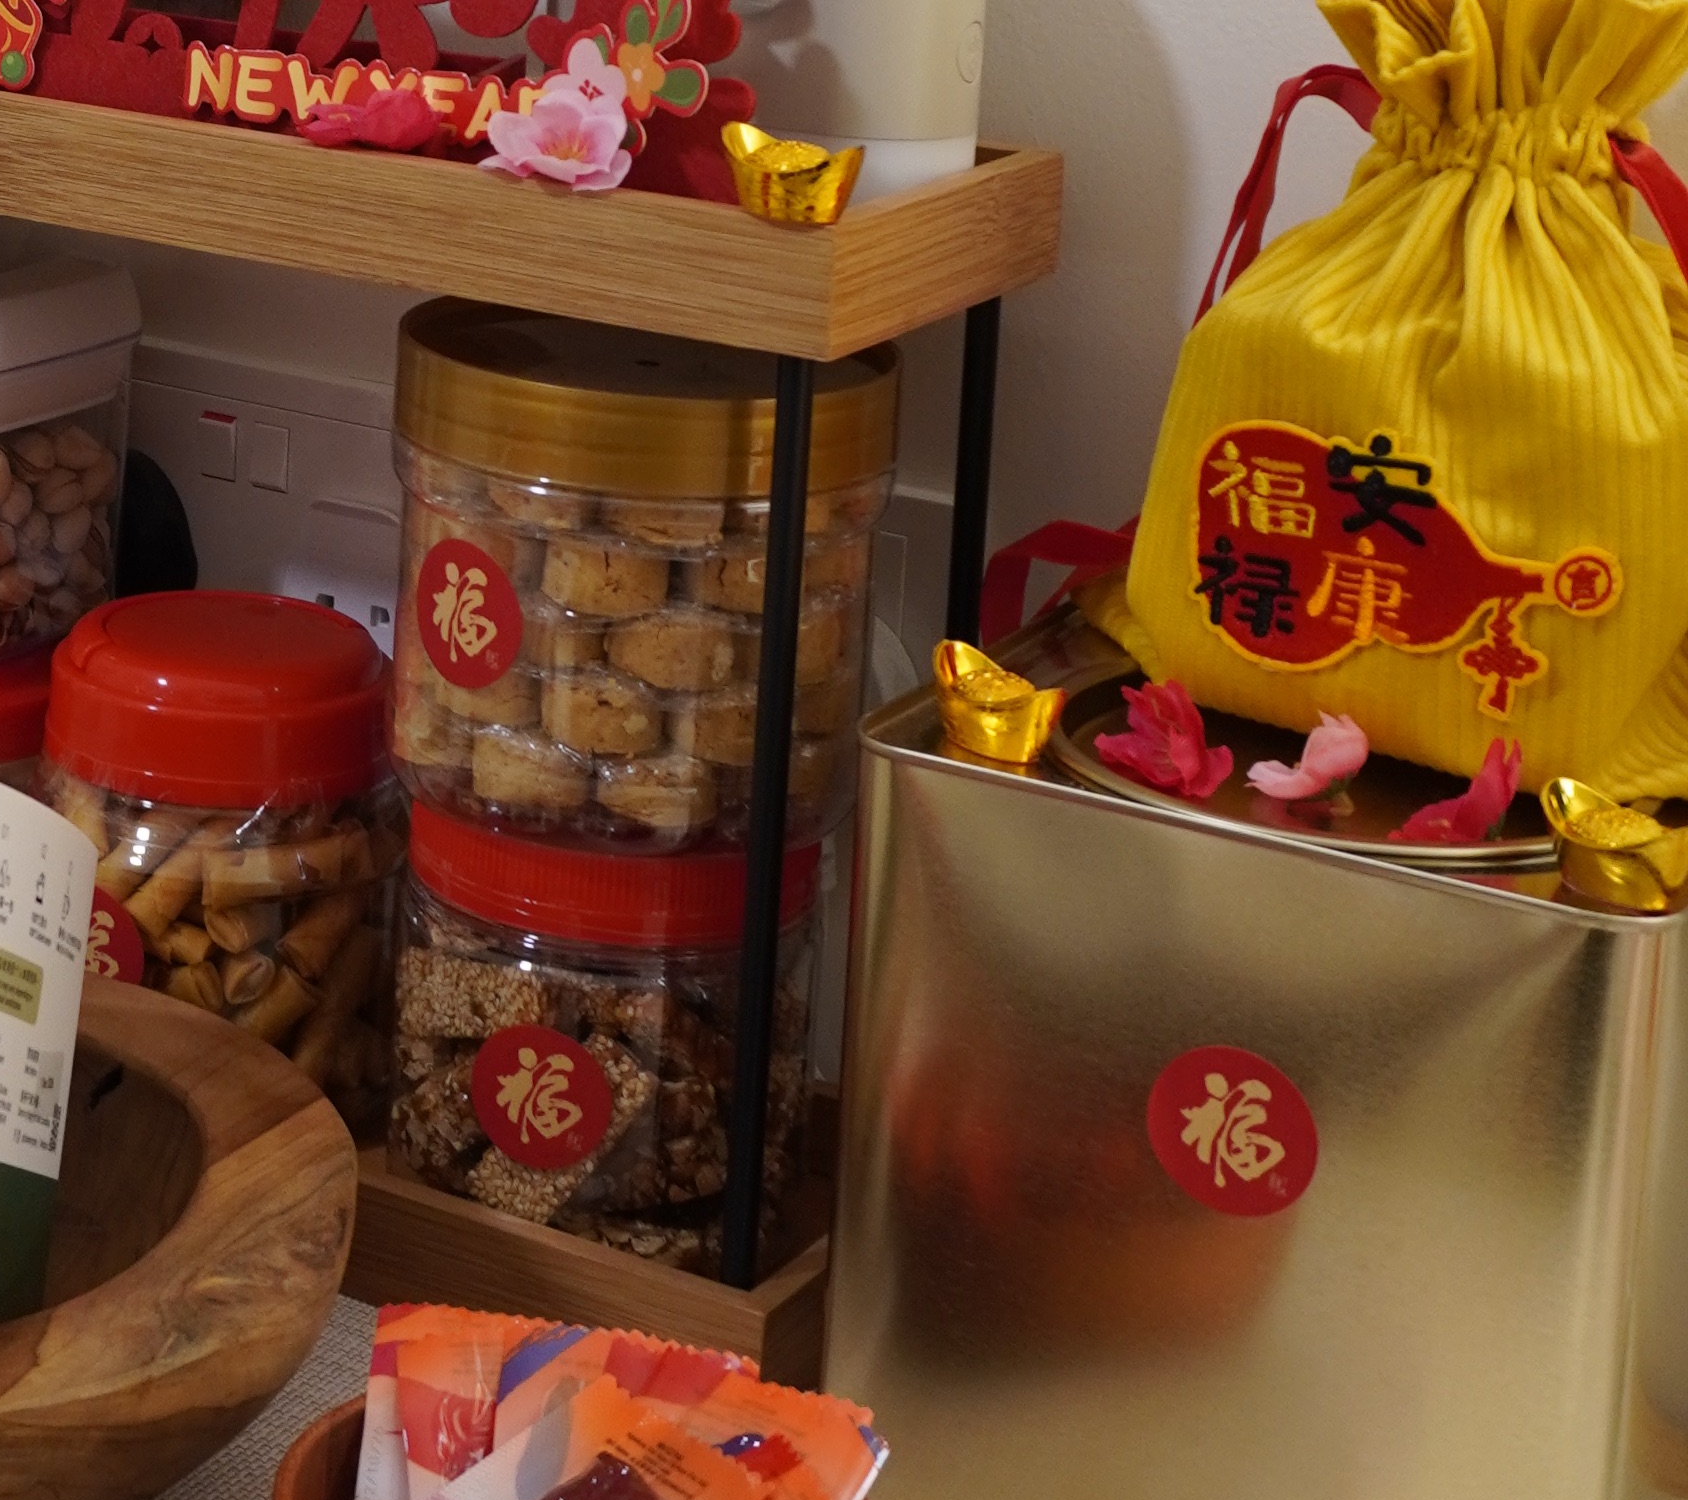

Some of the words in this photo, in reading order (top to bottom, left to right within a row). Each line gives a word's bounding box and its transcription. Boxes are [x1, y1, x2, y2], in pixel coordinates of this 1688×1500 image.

[432, 562, 498, 663] 福
[496, 1047, 583, 1144] 福
[1179, 1072, 1286, 1188] 福
